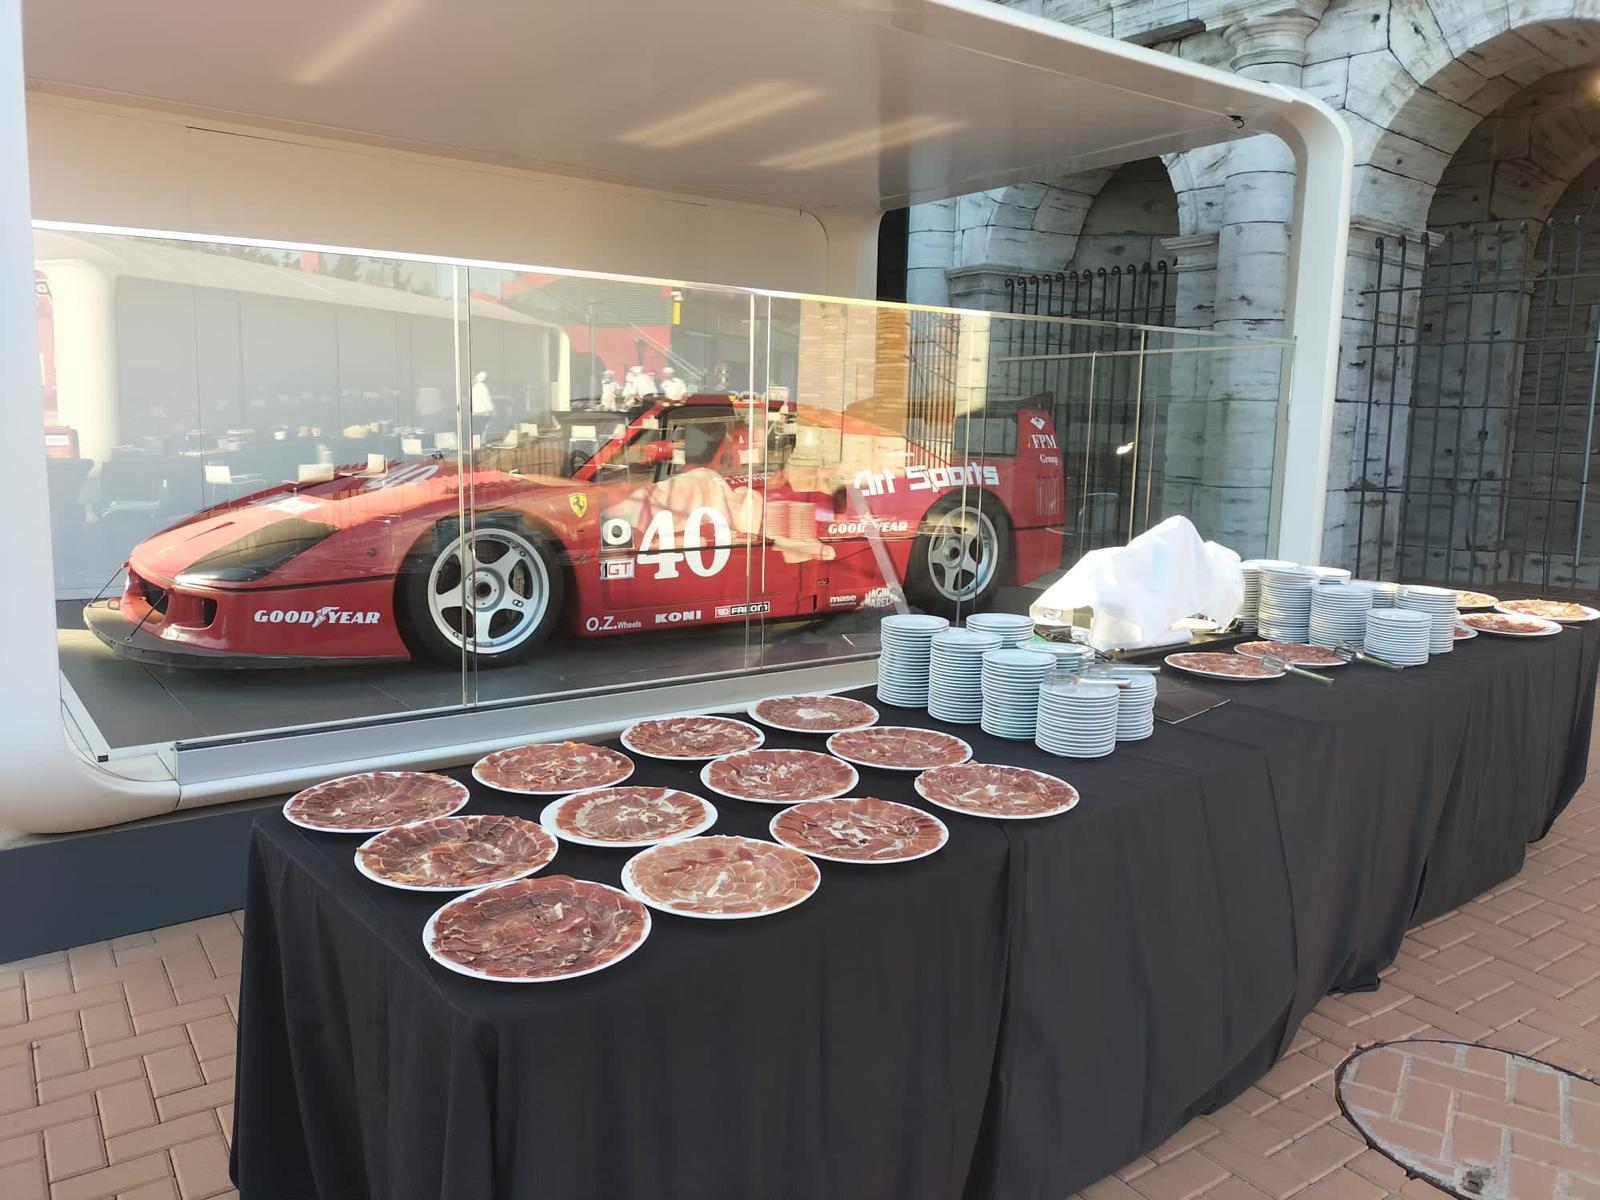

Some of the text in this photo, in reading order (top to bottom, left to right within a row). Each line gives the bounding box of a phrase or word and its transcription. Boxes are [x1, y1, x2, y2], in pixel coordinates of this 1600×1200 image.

[1031, 434, 1058, 449] FPM
[904, 462, 1000, 493] Sports
[637, 506, 732, 580] 40
[253, 609, 381, 625] GOODYEAR
[655, 610, 702, 624] KONI
